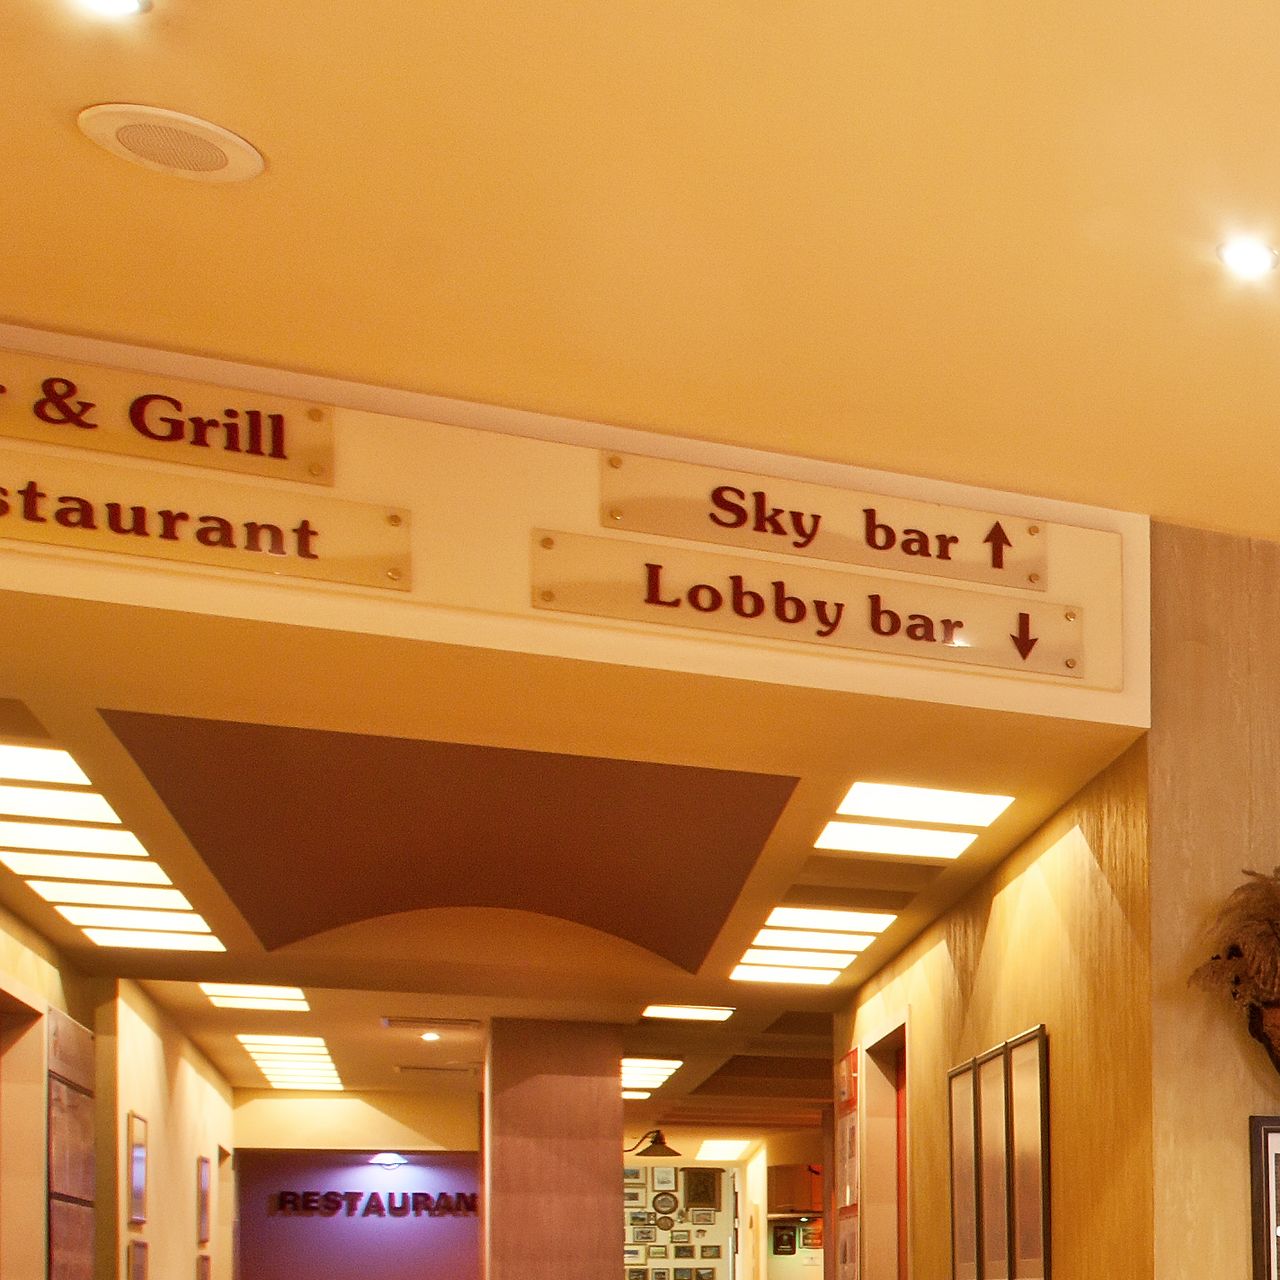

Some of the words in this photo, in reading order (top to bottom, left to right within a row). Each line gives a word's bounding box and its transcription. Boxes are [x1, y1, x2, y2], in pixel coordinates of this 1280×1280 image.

[33, 377, 98, 429] &
[128, 393, 288, 460] Grill
[708, 485, 822, 548] Sky
[863, 508, 959, 561] bar
[643, 562, 845, 637] Lobby
[868, 593, 965, 645] bar
